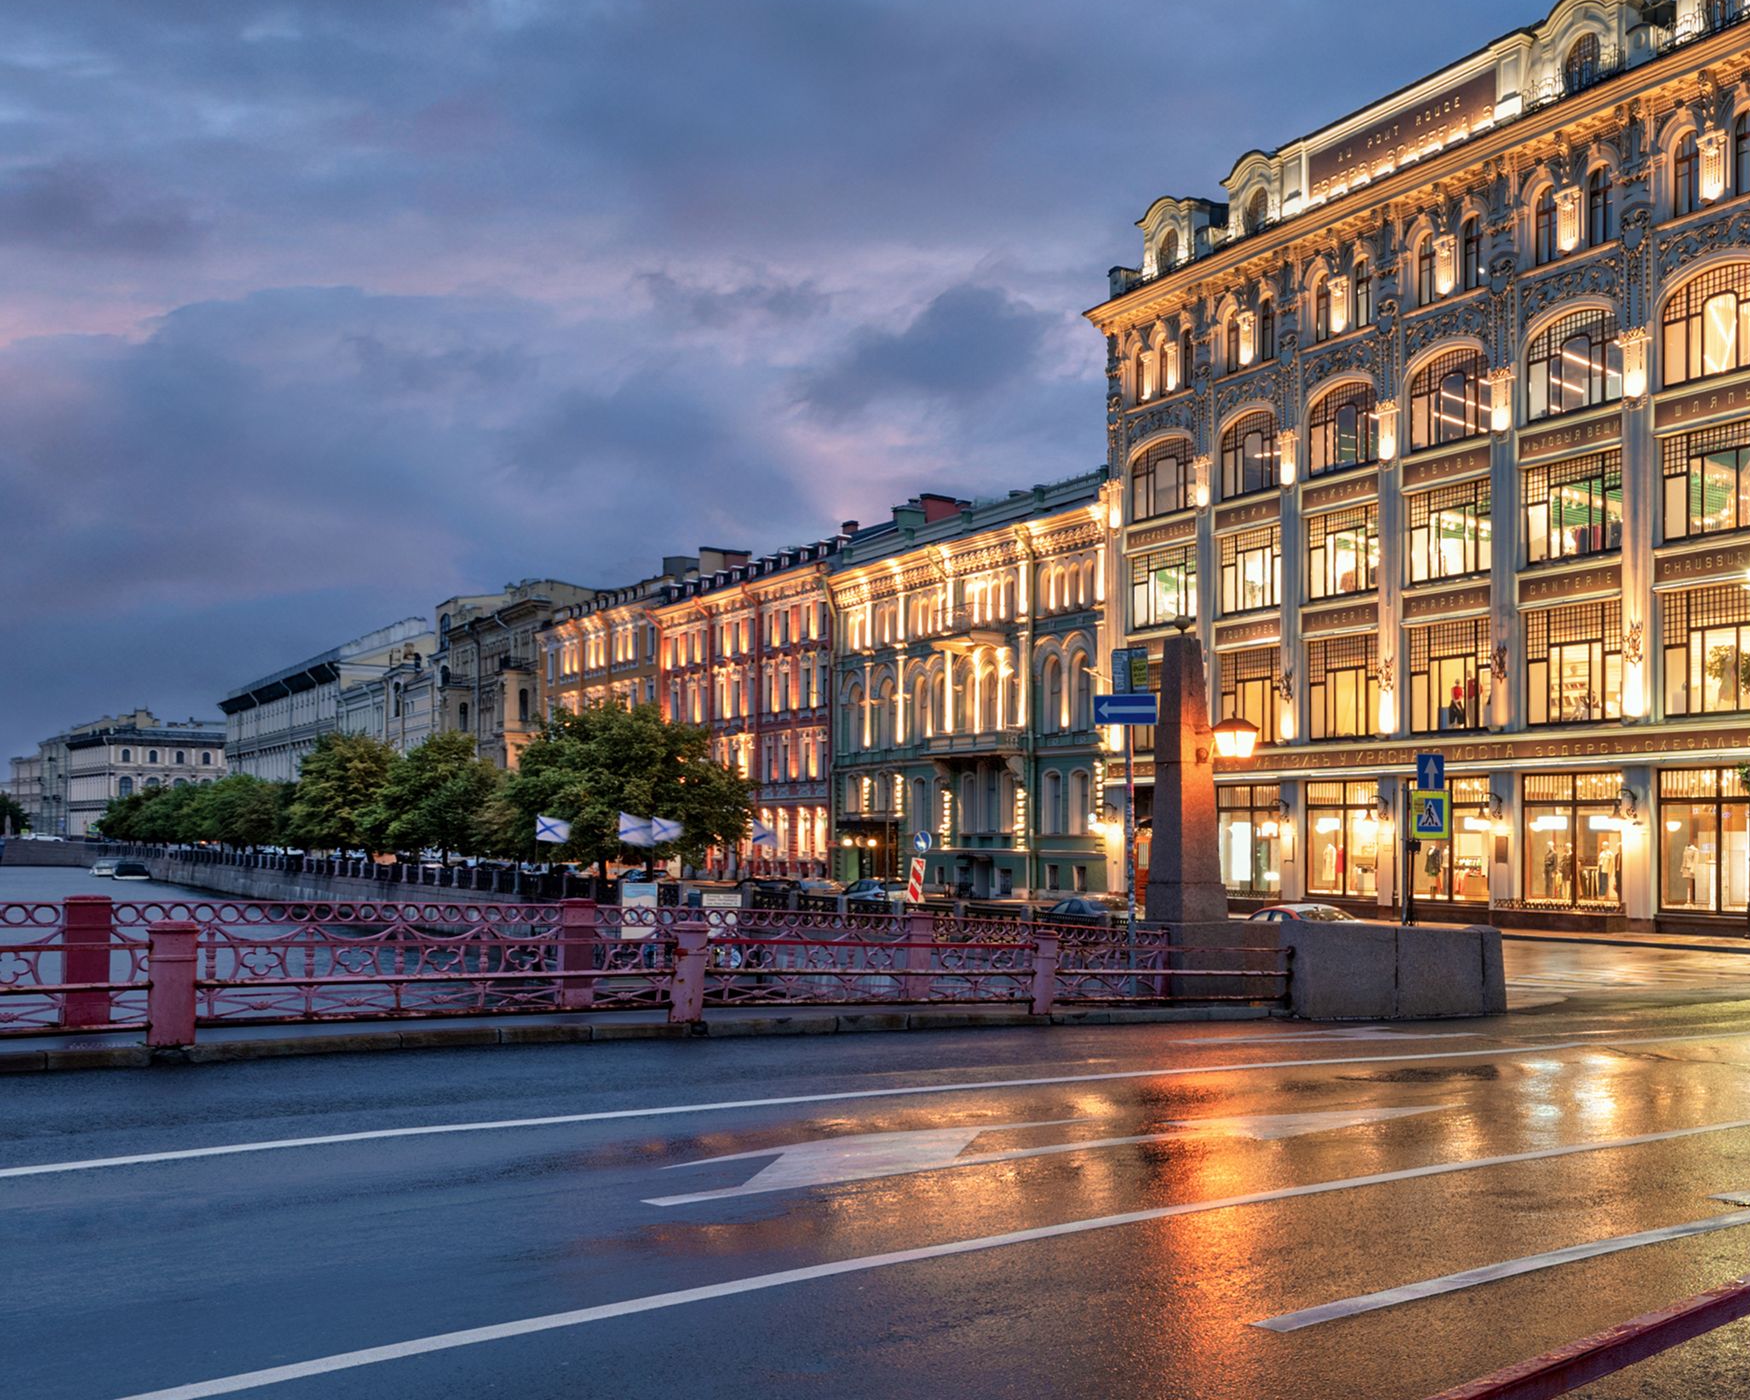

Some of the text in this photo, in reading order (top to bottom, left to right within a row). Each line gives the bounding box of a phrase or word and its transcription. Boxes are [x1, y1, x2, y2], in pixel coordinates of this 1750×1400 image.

[1337, 96, 1461, 162] AU PONT ROUGE
[1587, 419, 1620, 438] ВЕЩИ
[1419, 456, 1475, 477] ОБУВЬ
[1410, 592, 1485, 612] CHAPEAUX
[1340, 752, 1348, 766] У
[1452, 743, 1515, 761] МОСТА
[1535, 742, 1624, 757] ЭСДЕРСЪ
